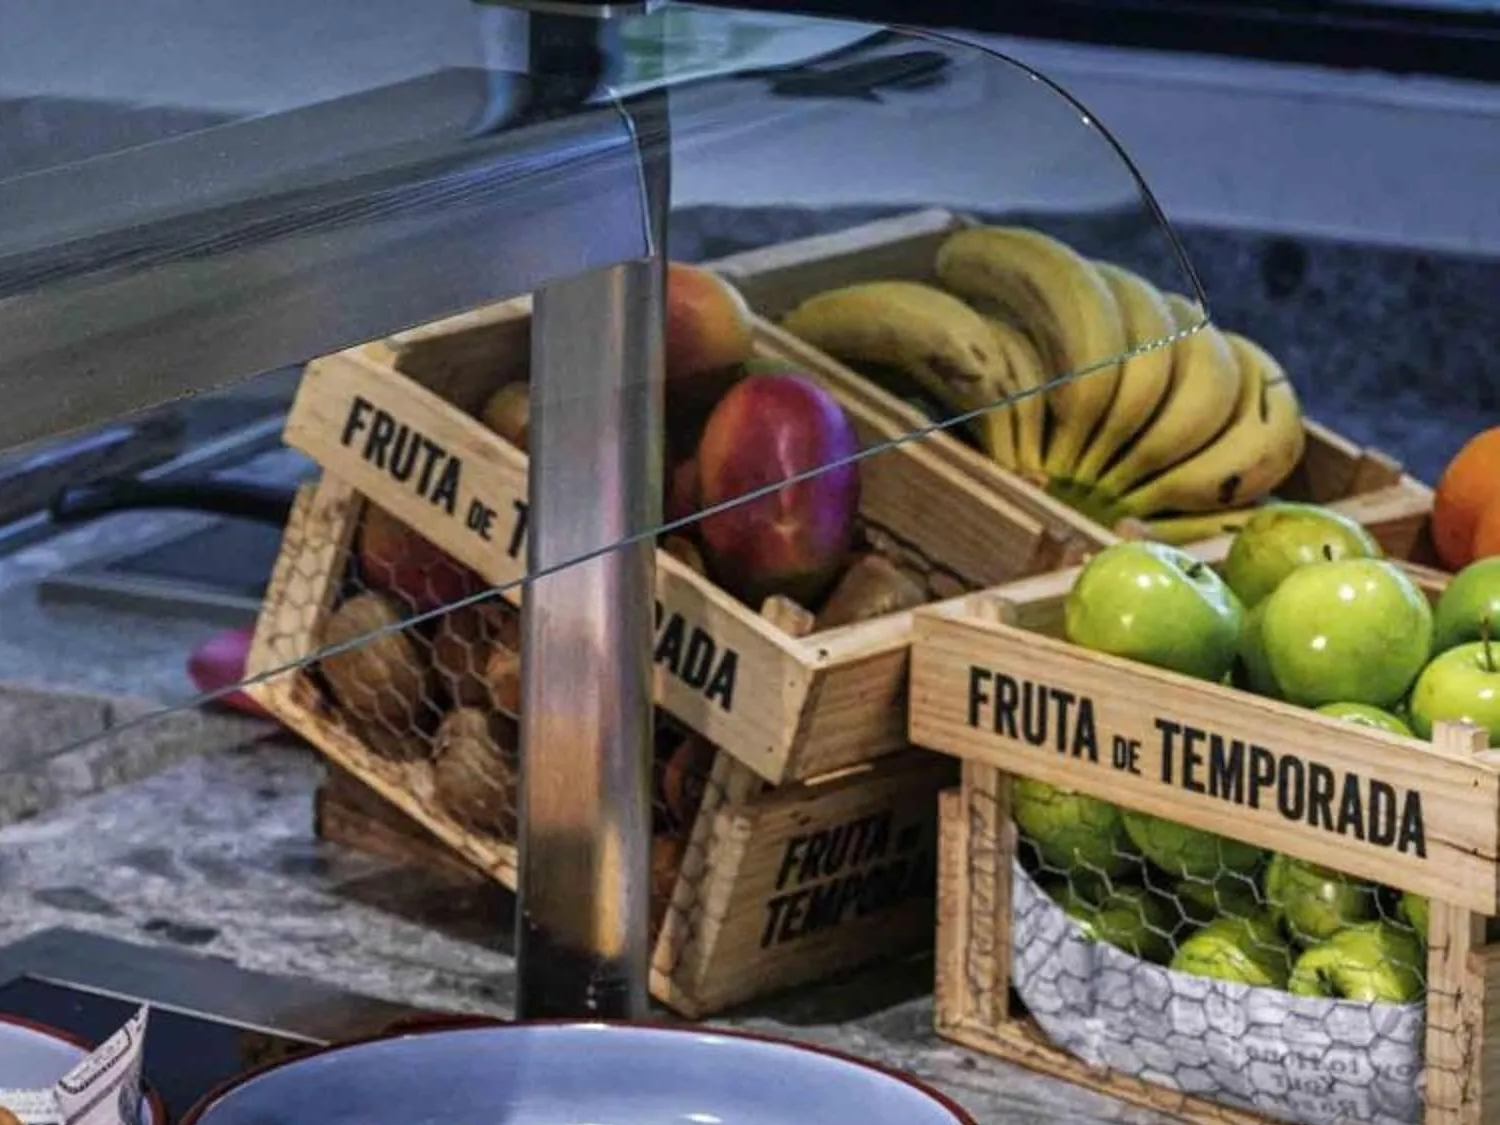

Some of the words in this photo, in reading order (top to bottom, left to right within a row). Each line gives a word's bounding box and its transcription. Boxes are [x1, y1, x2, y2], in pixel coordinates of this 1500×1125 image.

[340, 394, 462, 516] FRUTA
[466, 497, 498, 542] DE
[969, 665, 1099, 764] FRUTA
[1112, 734, 1143, 776] DE
[1155, 718, 1428, 860] TEMPORADA
[775, 809, 894, 891] FRUTA
